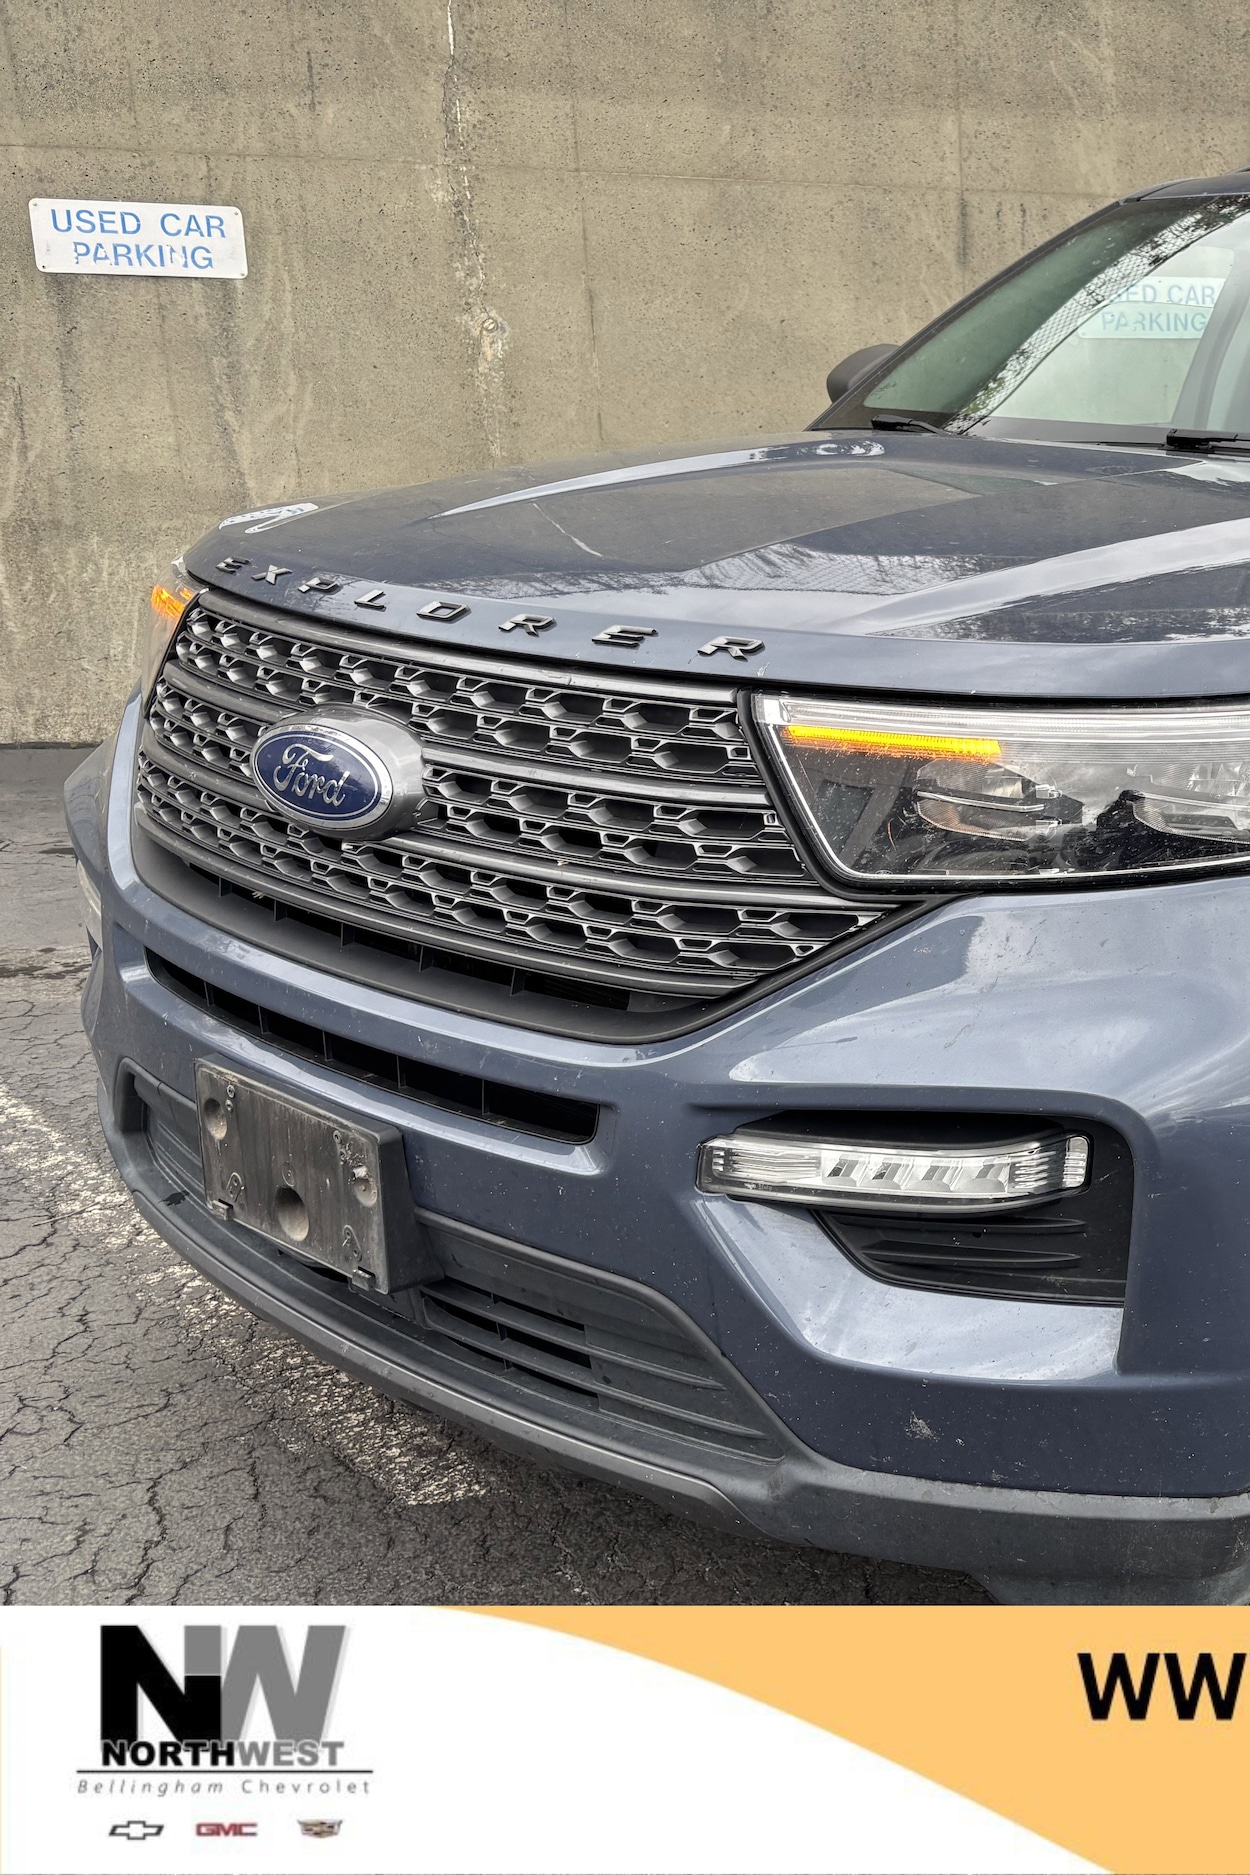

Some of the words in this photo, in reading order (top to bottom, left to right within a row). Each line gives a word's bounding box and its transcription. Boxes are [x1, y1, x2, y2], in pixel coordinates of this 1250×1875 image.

[51, 208, 142, 235] USED
[160, 213, 226, 239] CAR
[72, 241, 214, 269] PARKING
[1112, 284, 1157, 304] ED
[1167, 284, 1217, 305] CAR
[1101, 312, 1208, 332] PARKING
[215, 554, 767, 663] EXPLORER
[273, 743, 351, 807] Ford
